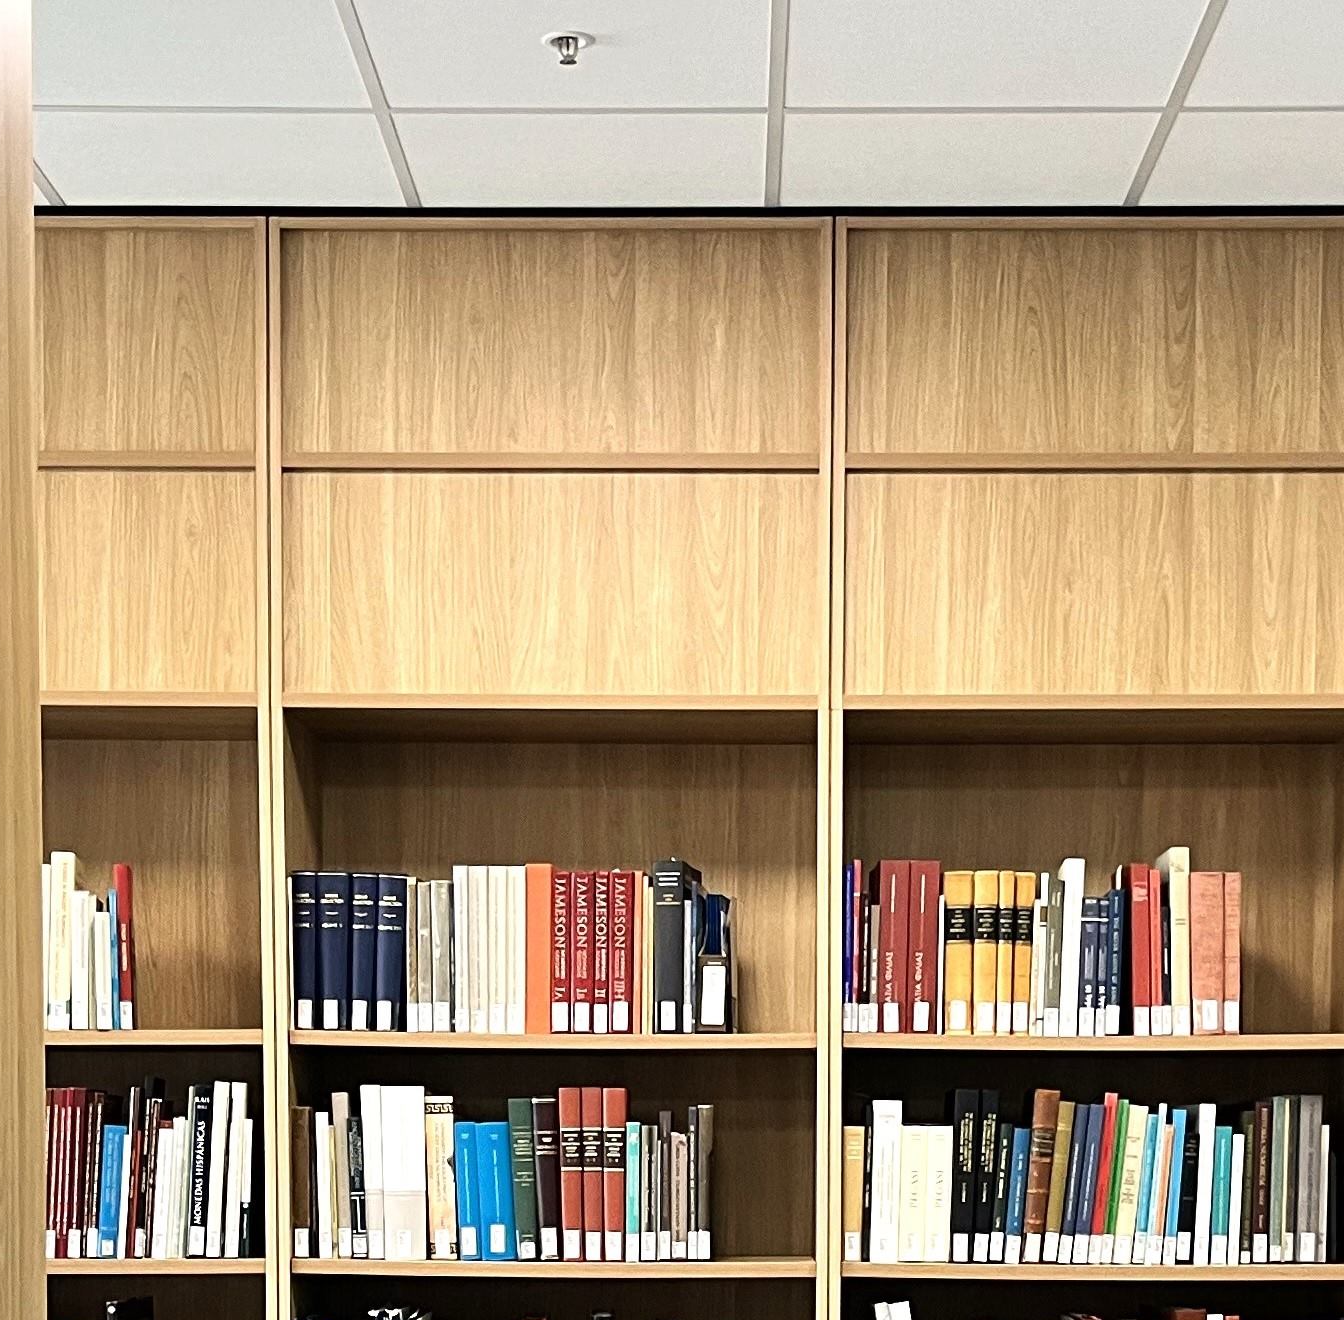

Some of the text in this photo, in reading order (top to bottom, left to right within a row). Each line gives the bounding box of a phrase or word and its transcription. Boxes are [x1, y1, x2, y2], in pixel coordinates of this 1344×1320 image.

[553, 878, 566, 949] JAMESON
[576, 877, 588, 948] JAMESON
[595, 878, 607, 948] JAMESON
[614, 878, 627, 948] JAMESON
[193, 1120, 206, 1225] MONEDAS HISPANICAS
